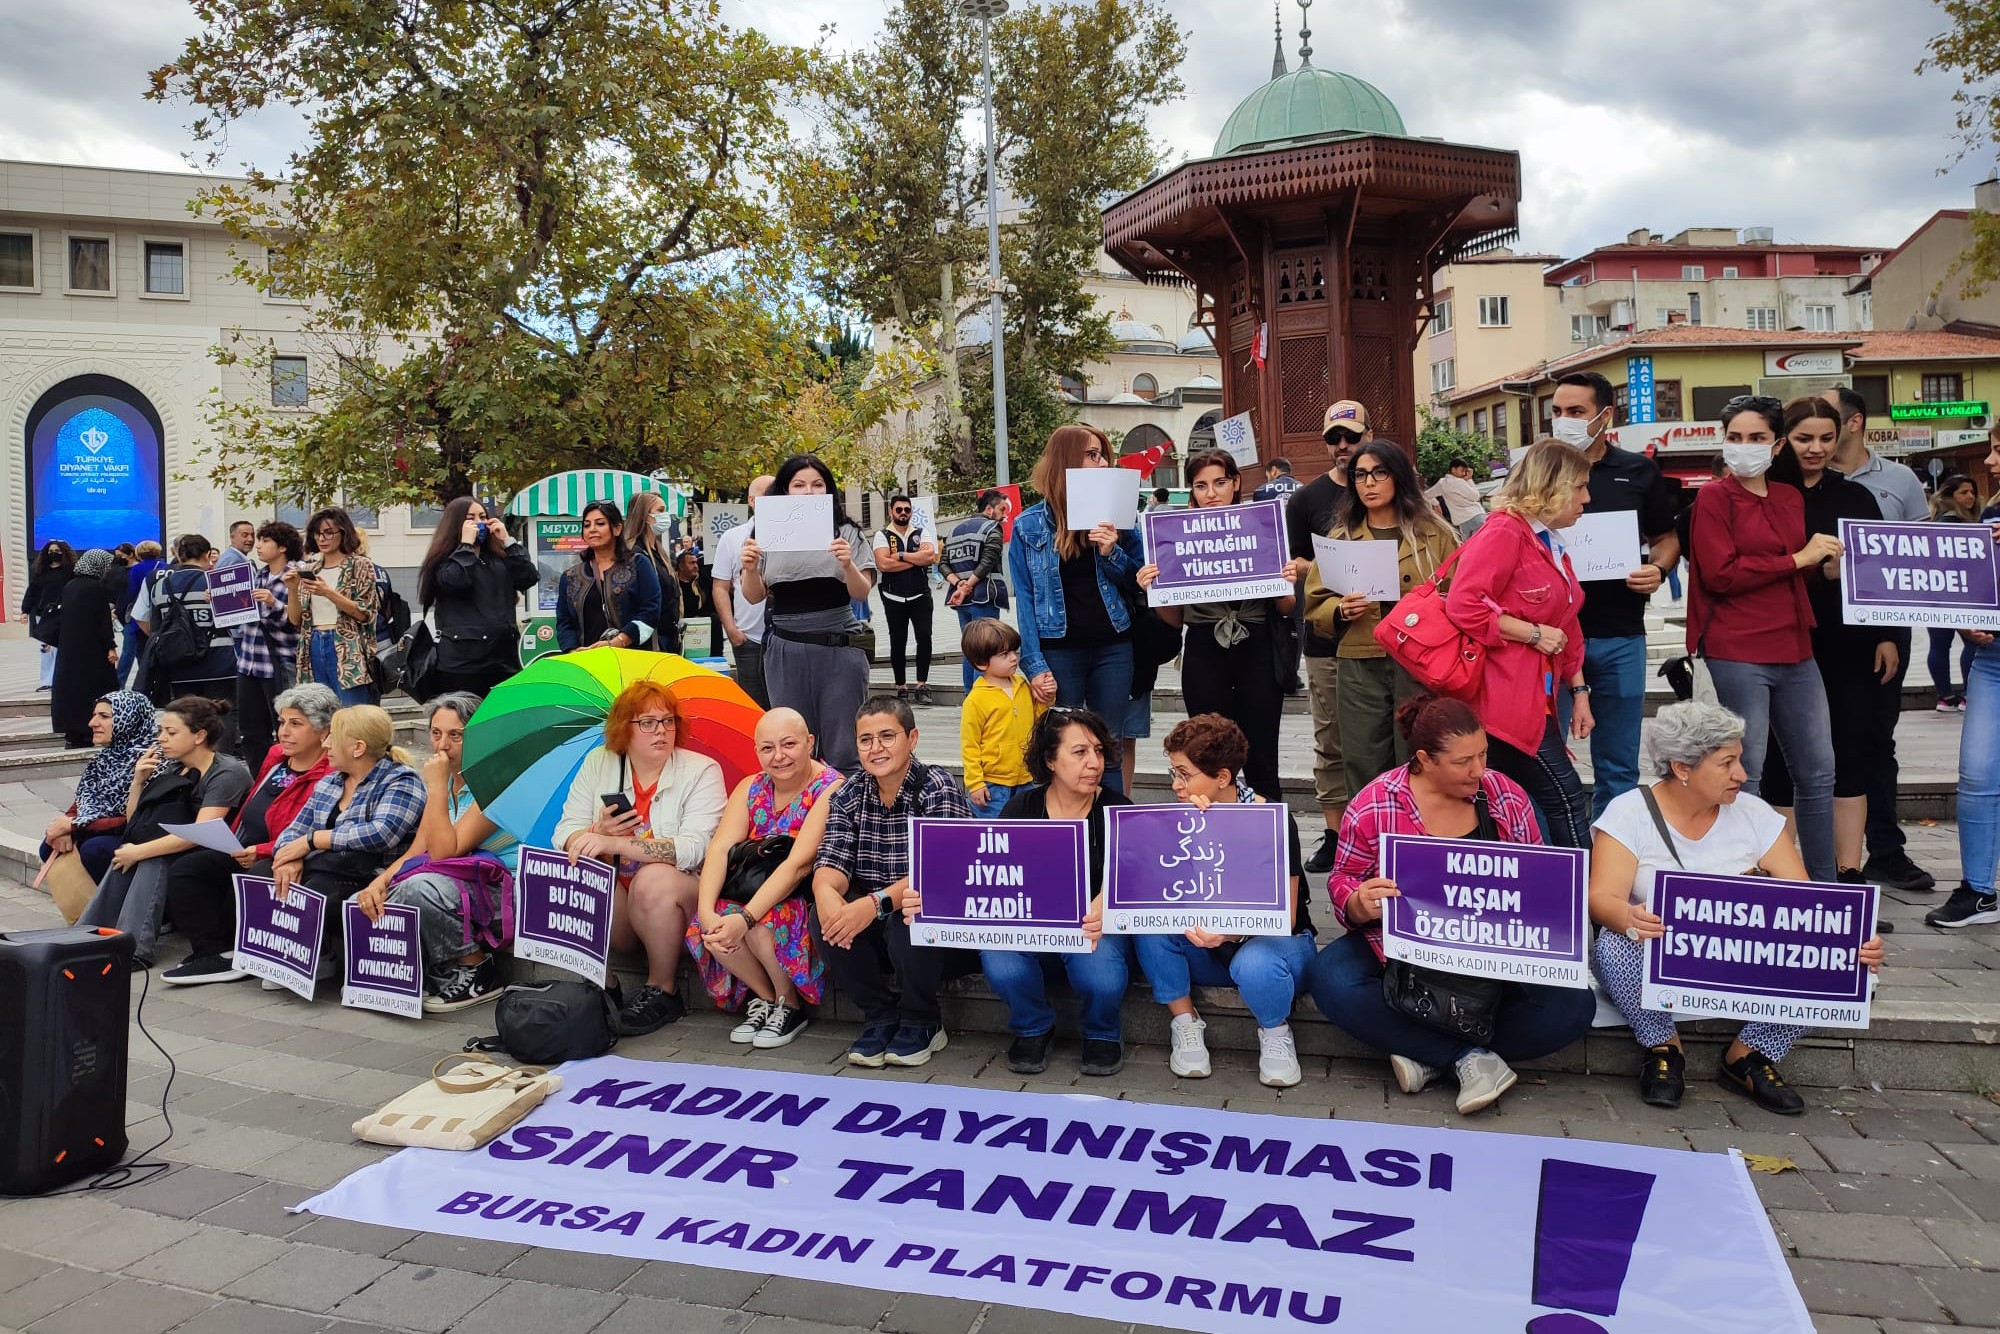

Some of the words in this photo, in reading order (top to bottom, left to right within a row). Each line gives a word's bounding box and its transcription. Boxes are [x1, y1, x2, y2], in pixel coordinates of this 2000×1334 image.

[1867, 430, 1899, 442] KOBRA
[1183, 513, 1241, 533] LAİKLİK
[1175, 534, 1258, 556] BAYRAĞINI
[1858, 528, 1930, 557] İSYAN
[1937, 536, 1986, 559] HER
[1182, 557, 1254, 577] YÜKSELT!
[1881, 568, 1968, 593] YERDE!
[1173, 590, 1202, 601] BURSA
[1204, 587, 1232, 598] KADIN
[1234, 583, 1287, 596] PLATFORMU
[1872, 611, 1906, 622] BURSA
[1909, 613, 1940, 623] KADIN
[1177, 811, 1206, 834] زن
[977, 827, 1009, 854] JİN
[1159, 836, 1225, 867] زندگی
[526, 859, 580, 882] KADINLAR
[581, 869, 609, 894] SUSMAZ
[965, 859, 1024, 886] JİYAN
[1447, 852, 1519, 879] KADIN
[1162, 868, 1225, 901] آزادی
[549, 885, 567, 905] BU
[569, 885, 595, 915] İSYAN
[964, 891, 1033, 919] AZADİ!
[1443, 884, 1521, 916] YAŞAM
[271, 909, 300, 934] KADIN
[548, 911, 594, 942] DURMAZ!
[1133, 915, 1169, 928] BURSA
[1172, 915, 1208, 928] KADIN
[1211, 915, 1283, 929] PLATFORMU
[1674, 896, 1766, 929] MAHSA
[1773, 903, 1852, 935] AMİNİ
[940, 930, 976, 944] BURSA
[978, 932, 1013, 945] KADIN
[1016, 933, 1084, 947] PLATFORMU
[1414, 909, 1550, 950] ÖZGÜRLÜK!
[247, 927, 311, 965] DAYANIŞMASI!
[369, 935, 407, 957] YERİNDEN
[535, 947, 559, 960] BURSA
[560, 951, 580, 967] KADIN
[1665, 925, 1856, 971] İSYANIMIZDIR!
[249, 960, 269, 974] BURSA
[269, 966, 287, 982] KADIN
[286, 972, 311, 994] PLATFORMU
[358, 958, 414, 982] OYNATACAĞIZ!
[1414, 948, 1454, 967] BURSA
[1457, 956, 1497, 973] KADIN
[1501, 961, 1579, 982] PLATFORMU
[357, 993, 374, 1005] BURSA
[373, 994, 391, 1008] KADIN
[391, 997, 419, 1014] PLATFORMU
[1682, 994, 1727, 1012] BURSA
[1731, 1000, 1775, 1016] KADIN
[1779, 1004, 1861, 1022] PLATFORMU
[569, 1078, 830, 1127] KADIN
[831, 1099, 1454, 1192] DAYANIŞMASI
[488, 1125, 799, 1190] SINIR
[834, 1158, 1415, 1262] TANIMAZ
[438, 1190, 646, 1236] BURSA
[656, 1216, 874, 1264] KADIN
[883, 1243, 1342, 1325] PLATFORMU
